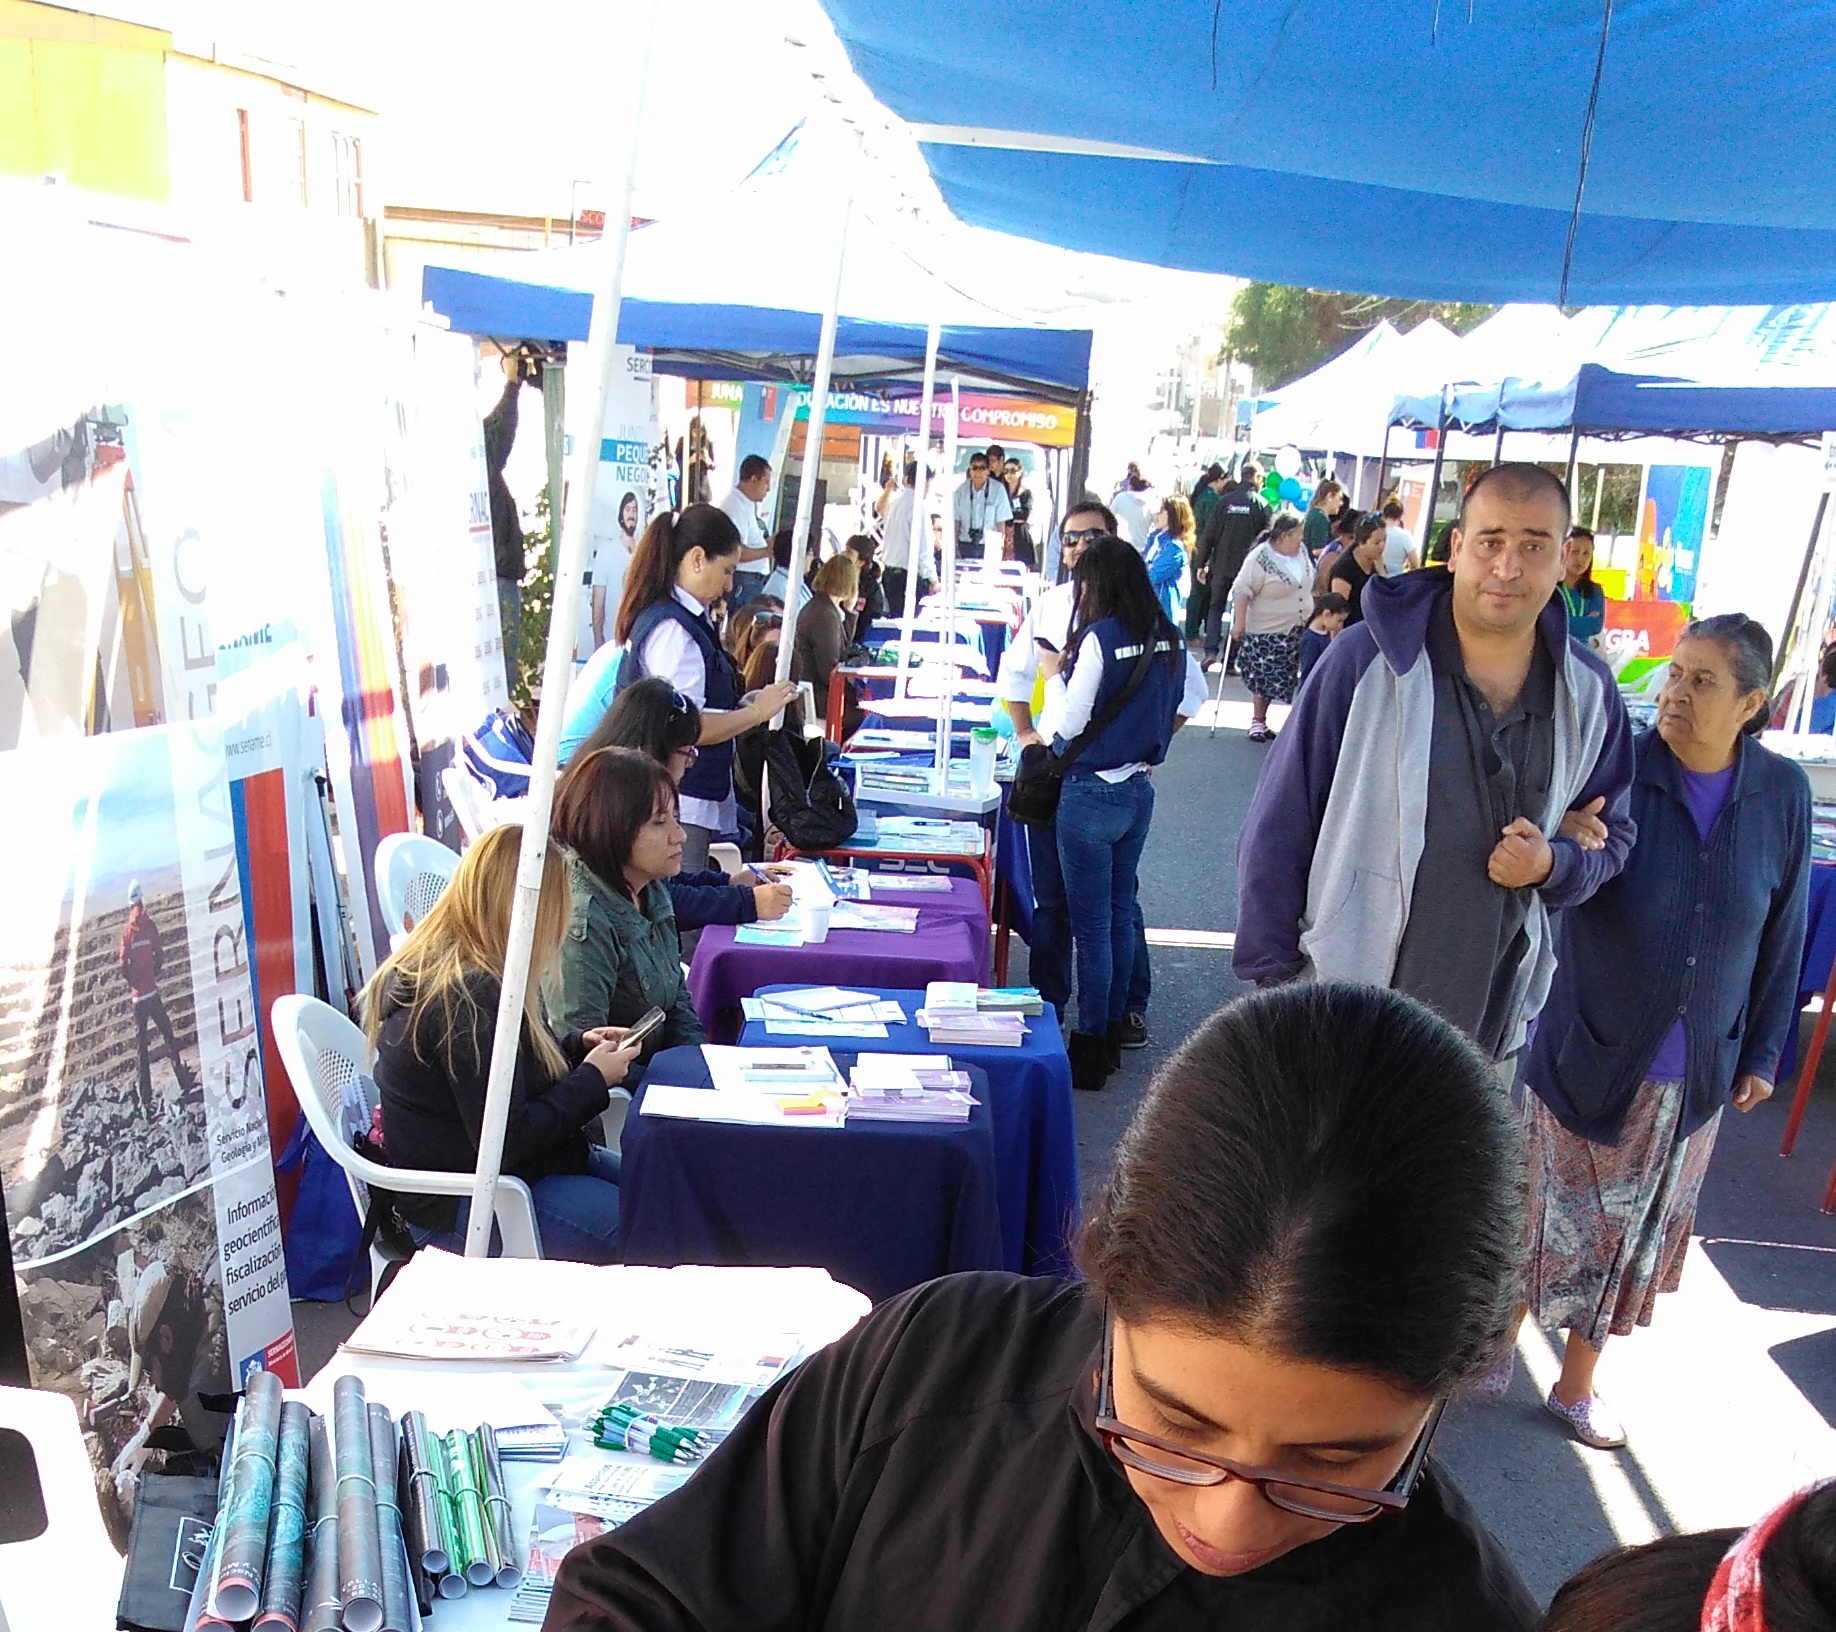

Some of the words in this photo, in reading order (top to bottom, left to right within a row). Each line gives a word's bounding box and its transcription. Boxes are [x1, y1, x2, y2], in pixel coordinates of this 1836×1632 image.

[870, 397, 890, 413] ES
[961, 406, 1058, 430] COMPROMISO
[216, 1130, 245, 1147] Servicio
[228, 1283, 266, 1315] servicio
[267, 1271, 280, 1296] del
